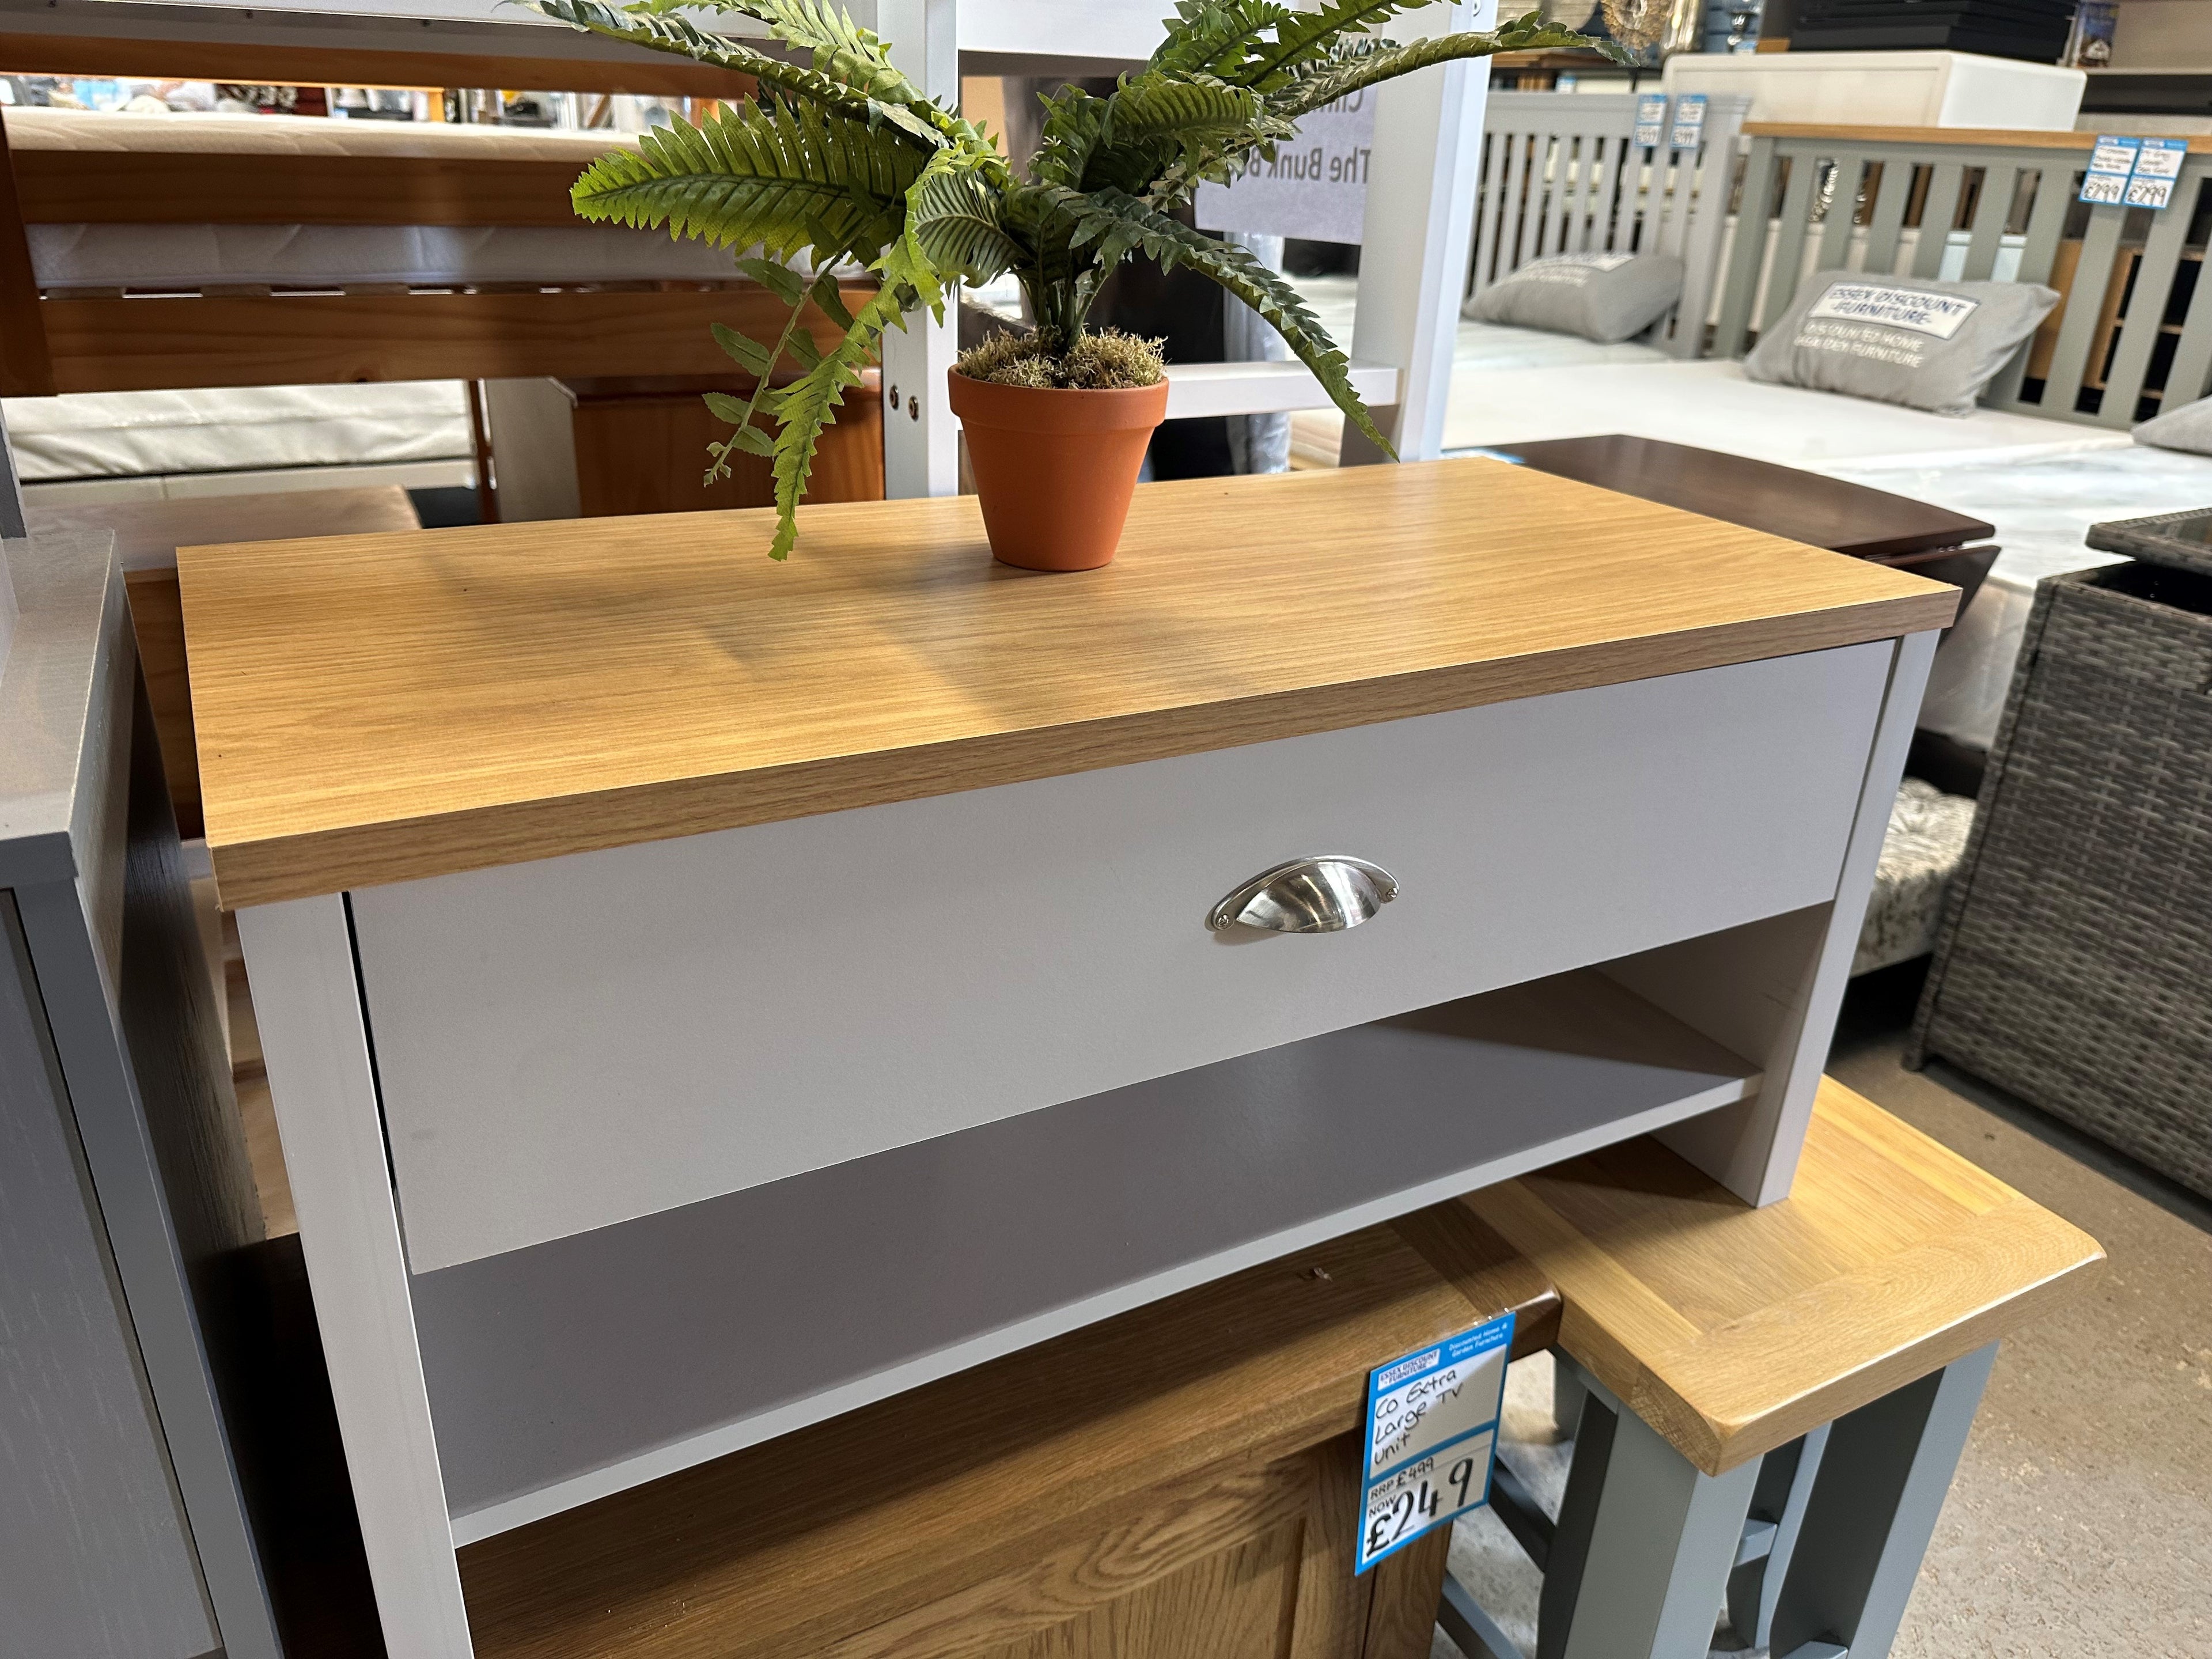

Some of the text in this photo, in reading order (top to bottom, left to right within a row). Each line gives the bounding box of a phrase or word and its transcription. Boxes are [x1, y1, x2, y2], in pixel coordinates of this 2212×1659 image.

[1828, 289, 1967, 315] ESSEX DISCOUNT
[1836, 301, 1931, 325] FURNITURE
[1380, 1350, 1438, 1381] ESSEX DISCOUNT
[1406, 1369, 1456, 1403] Extra
[1375, 1382, 1463, 1444] Large TV
[1370, 1456, 1434, 1500] RRP £499
[1367, 1458, 1473, 1557] £249
[1369, 1494, 1396, 1518] NOW
